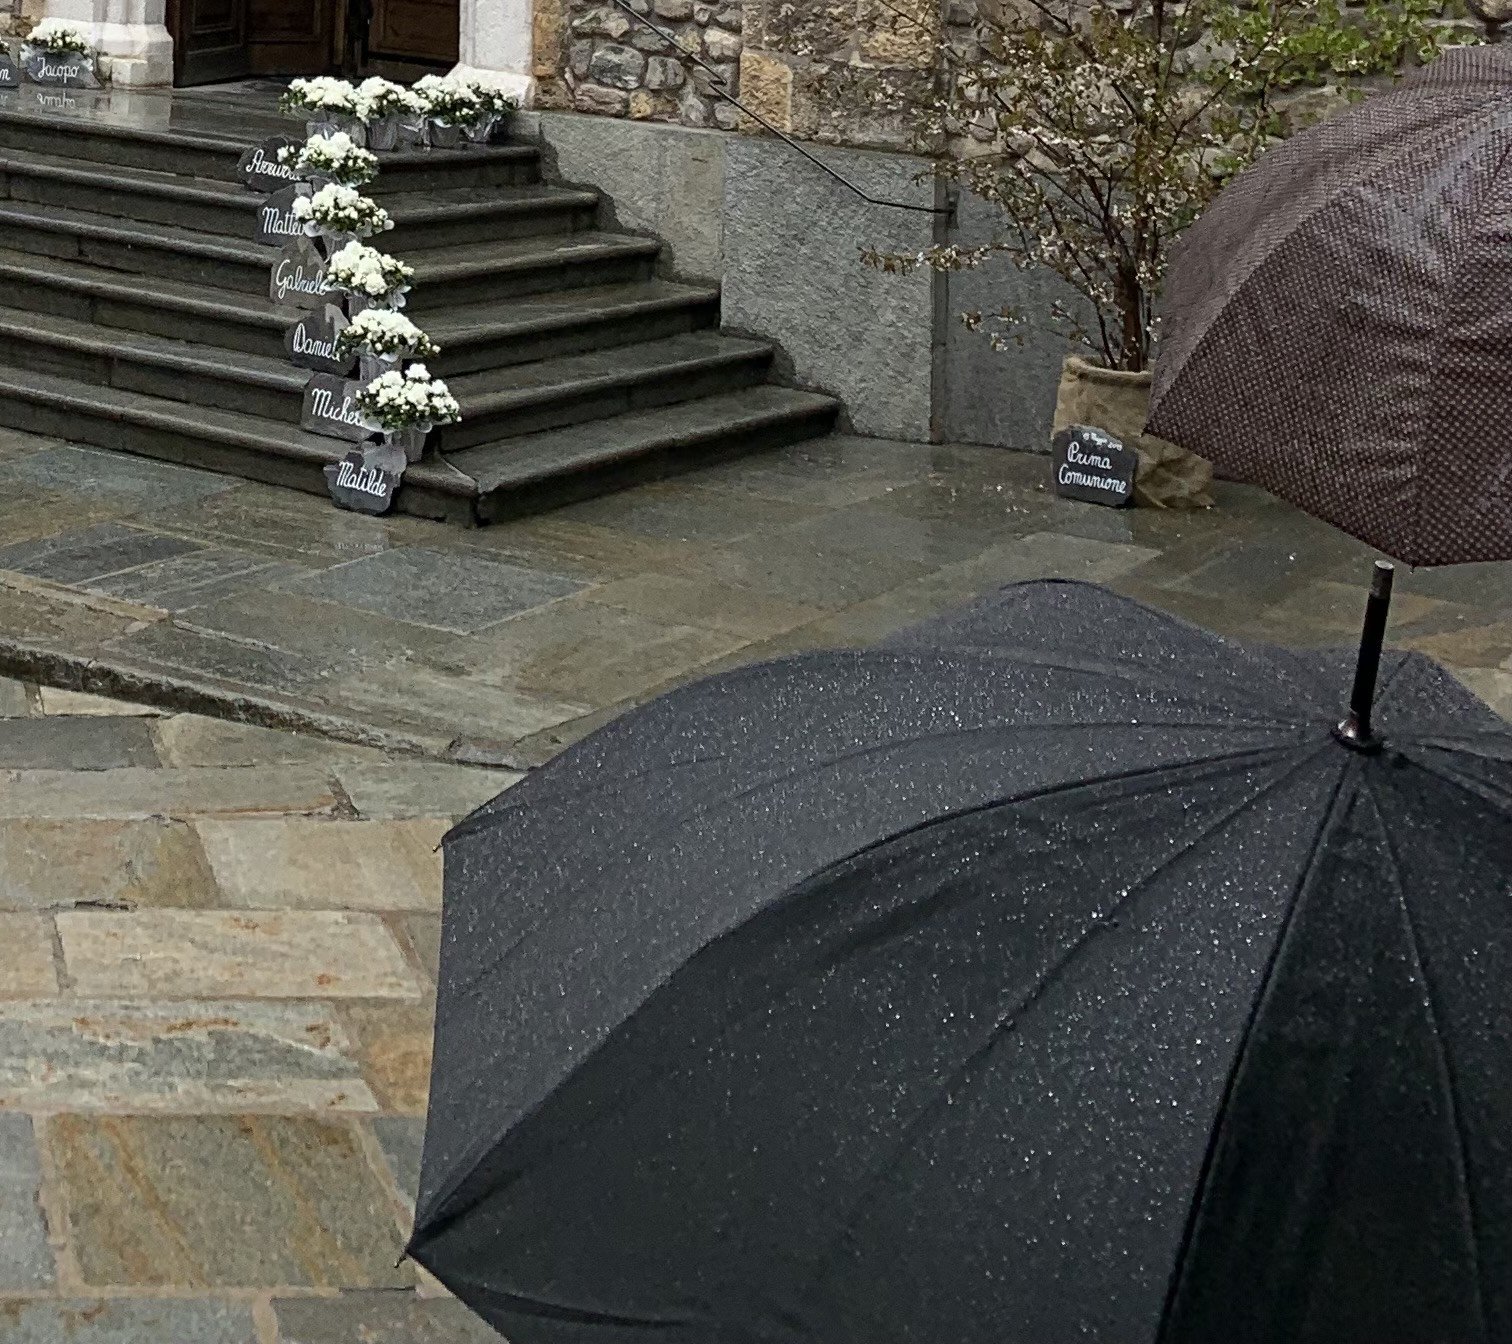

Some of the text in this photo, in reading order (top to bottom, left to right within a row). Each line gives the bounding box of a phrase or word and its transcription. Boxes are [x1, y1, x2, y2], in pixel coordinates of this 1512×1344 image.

[36, 56, 80, 84] Jacopo
[293, 322, 341, 363] Daniel
[1067, 441, 1113, 470] Prima
[336, 460, 387, 498] Matilde
[1058, 463, 1127, 494] Comunione
